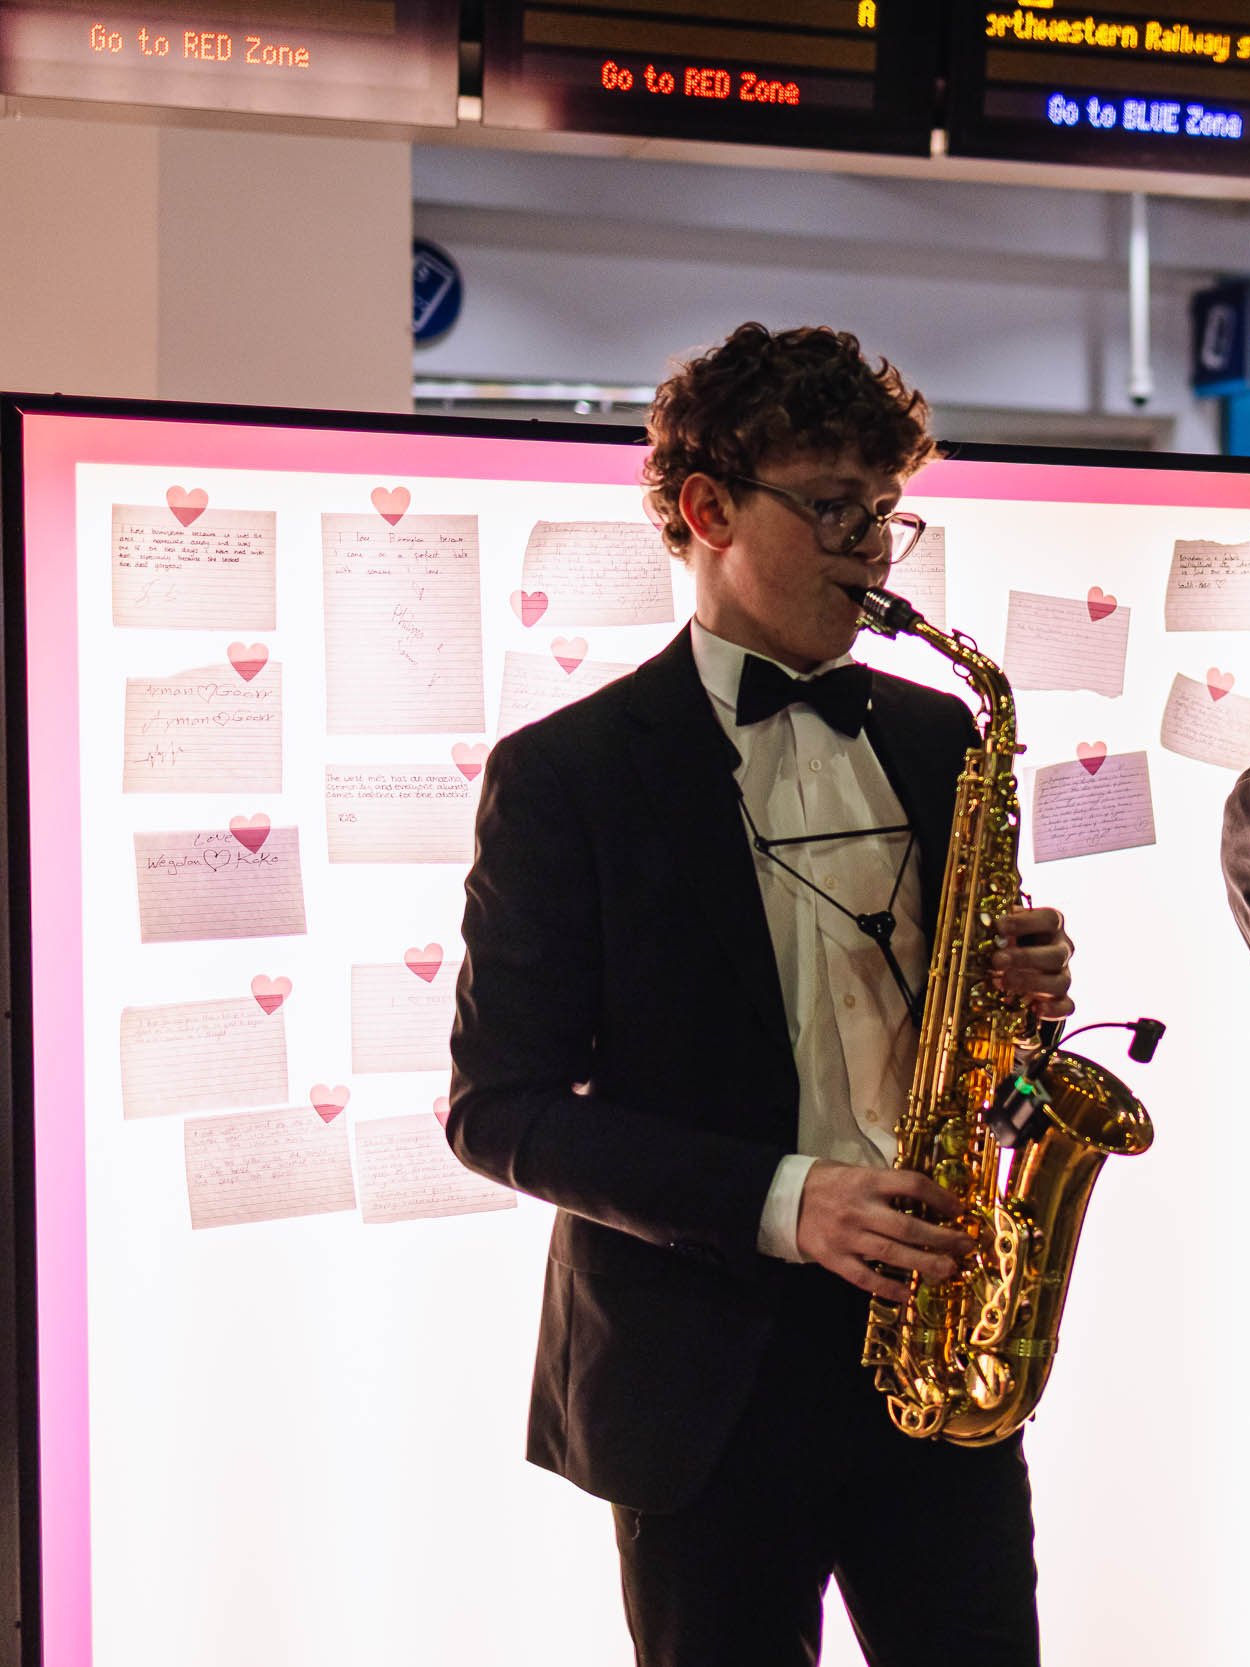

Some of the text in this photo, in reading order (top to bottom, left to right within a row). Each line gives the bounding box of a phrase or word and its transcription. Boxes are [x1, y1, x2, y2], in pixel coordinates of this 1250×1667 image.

[90, 24, 310, 68] Go to RED Zone
[1144, 21, 1231, 63] Railway
[601, 59, 800, 105] Go to RED Zone
[1047, 92, 1243, 139] Go to BLUE Zone
